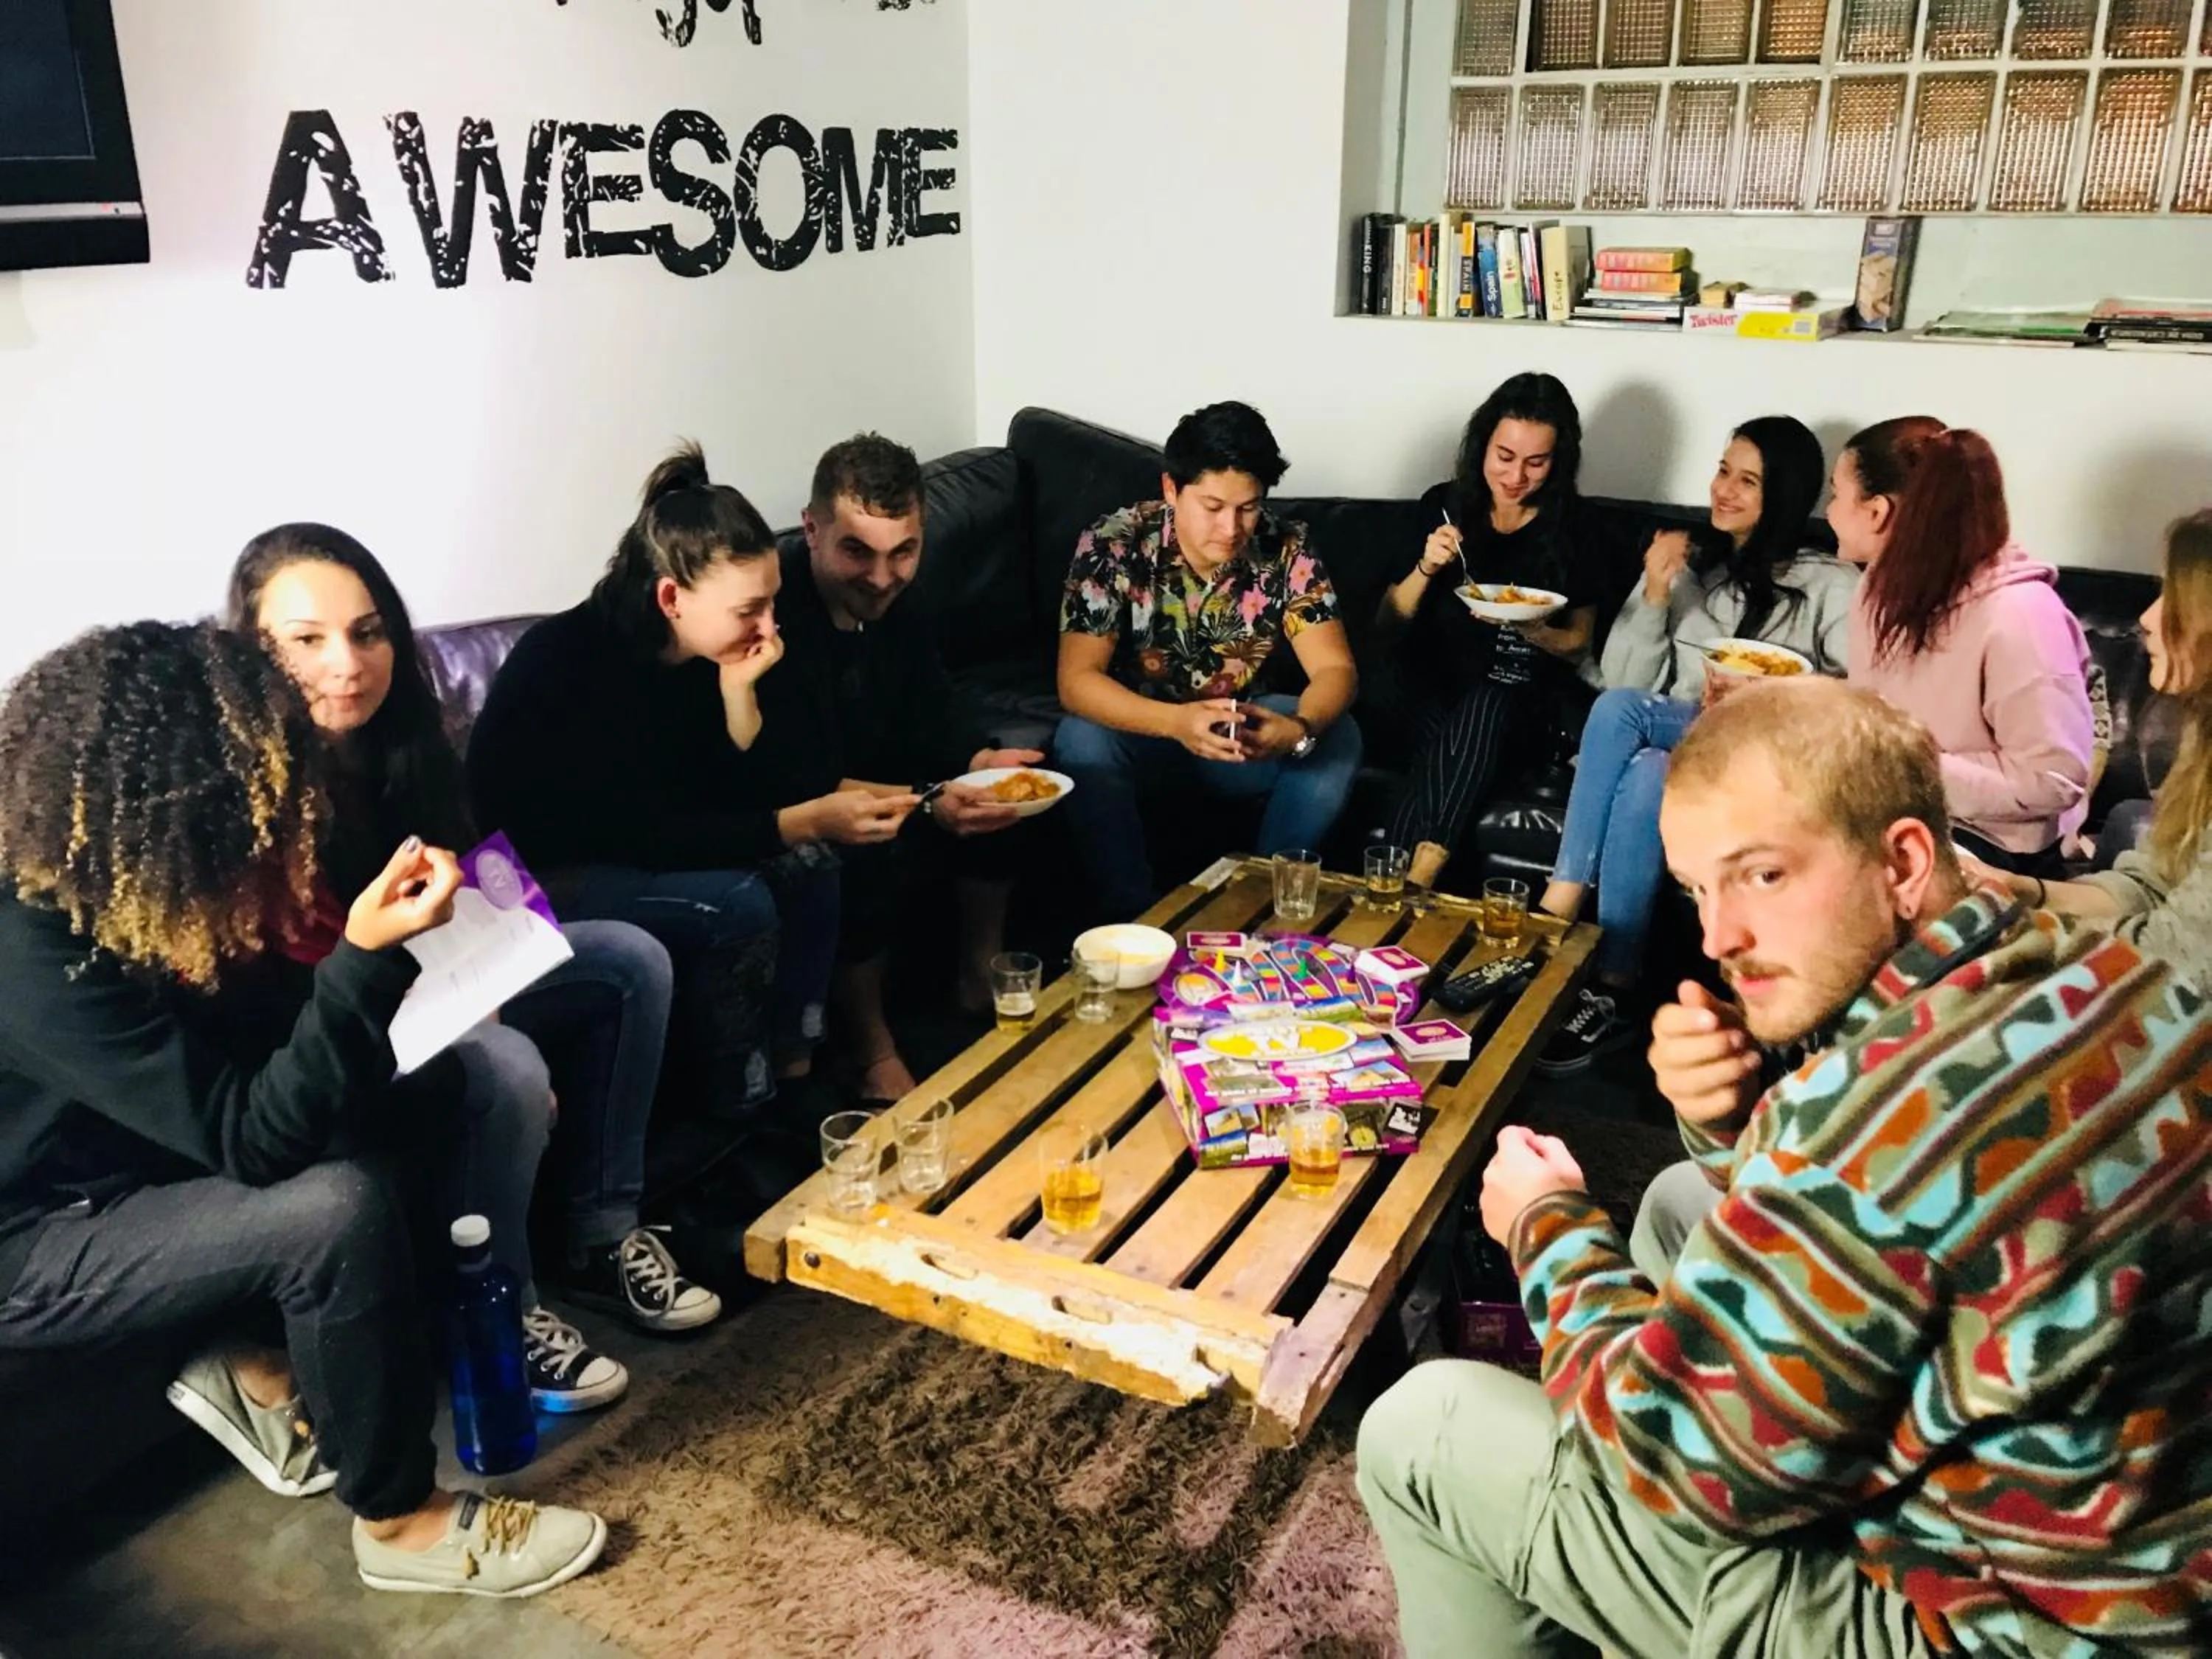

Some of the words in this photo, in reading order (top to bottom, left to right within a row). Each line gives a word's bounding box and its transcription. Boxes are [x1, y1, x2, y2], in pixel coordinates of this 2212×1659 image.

[247, 109, 960, 288] AWESOME
[1363, 244, 1372, 274] KING
[1462, 259, 1472, 291] SPAIN
[1486, 271, 1498, 302] Spain
